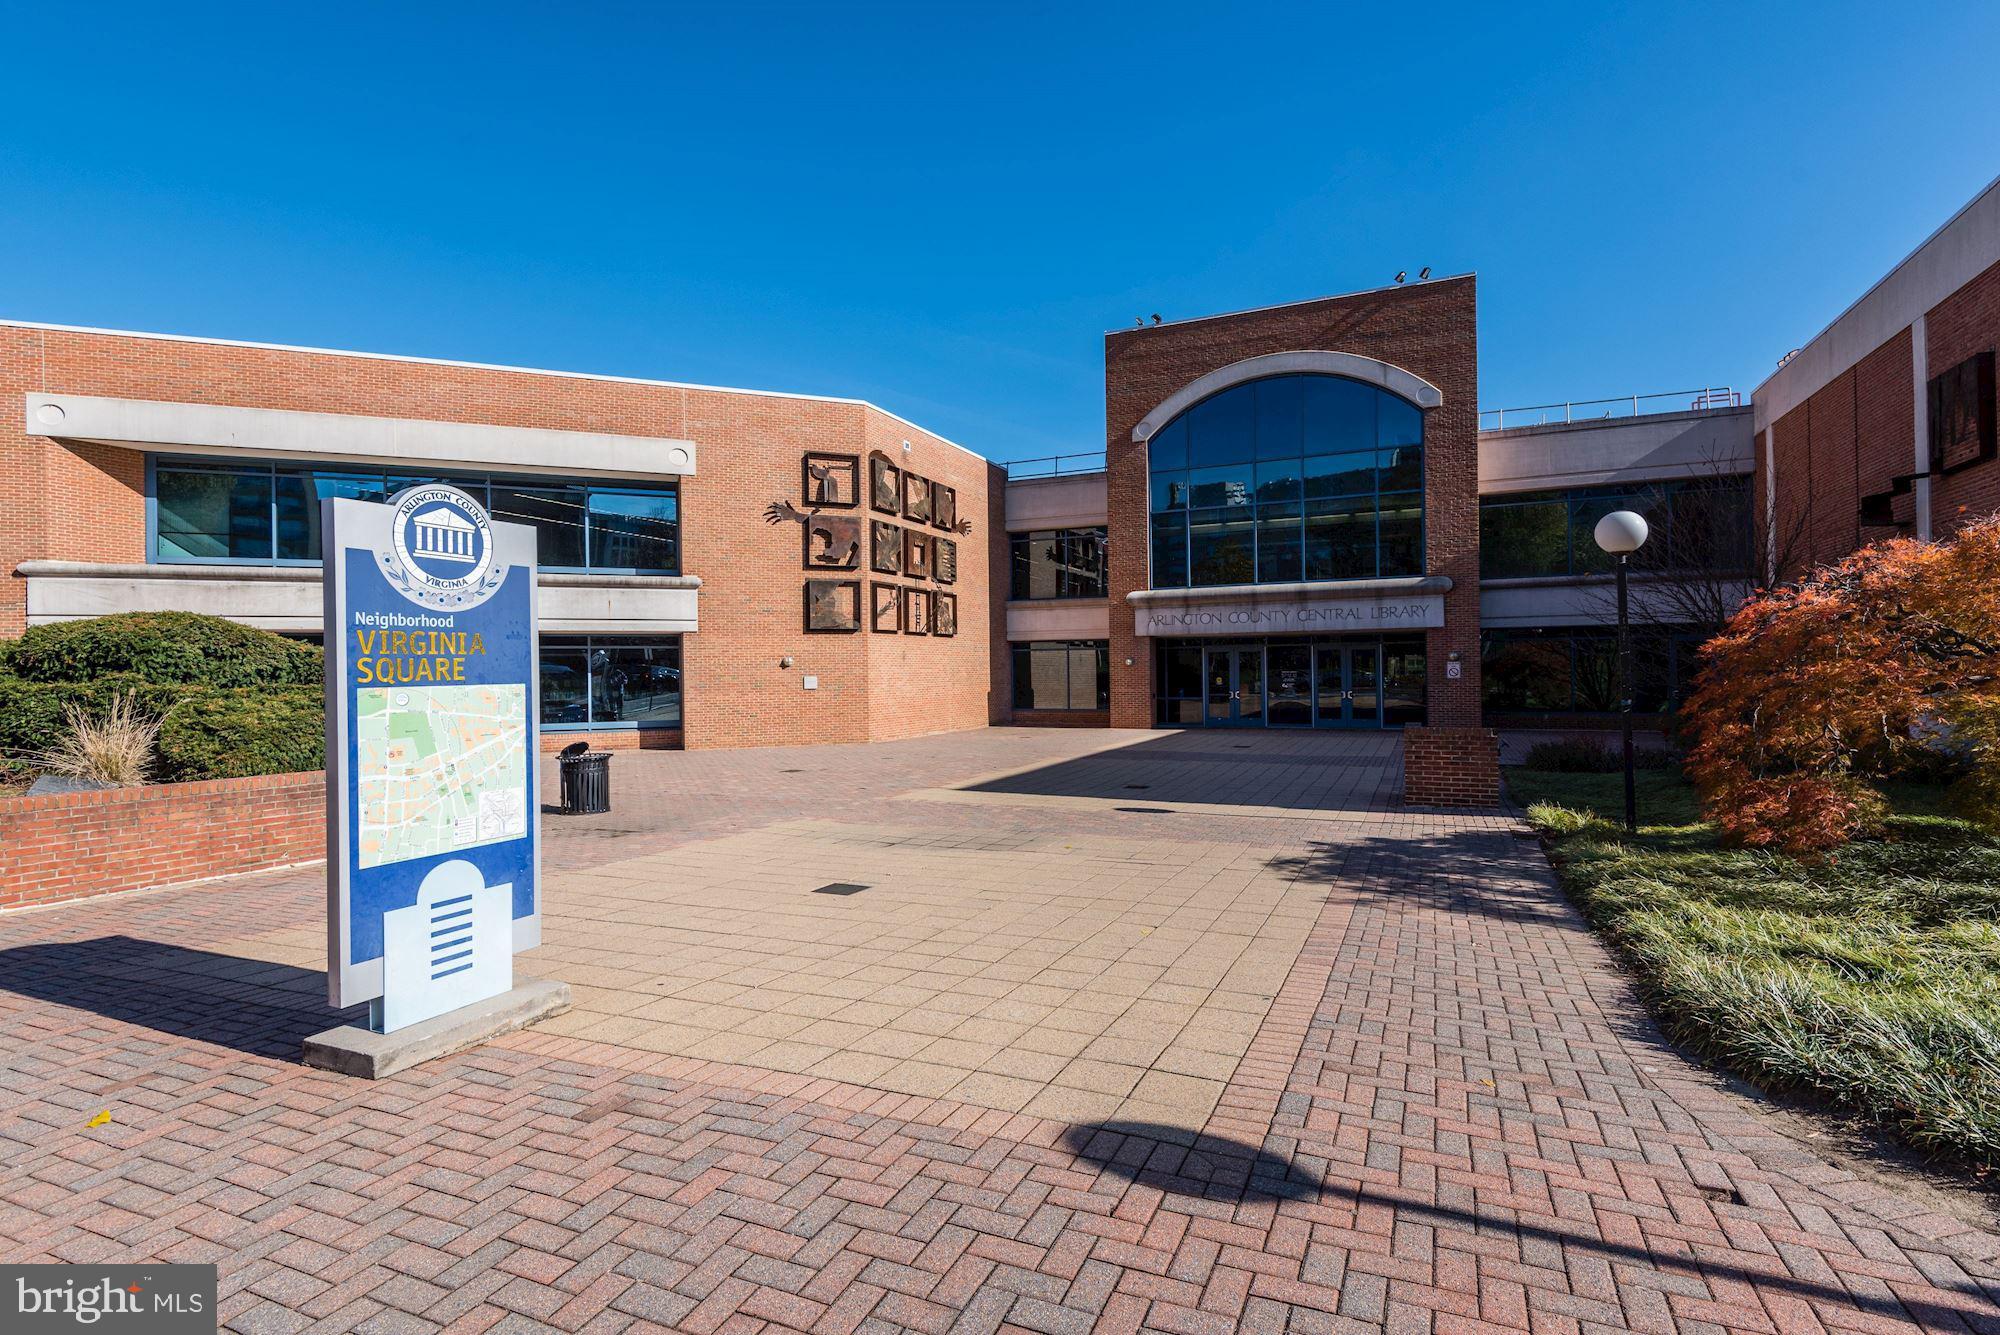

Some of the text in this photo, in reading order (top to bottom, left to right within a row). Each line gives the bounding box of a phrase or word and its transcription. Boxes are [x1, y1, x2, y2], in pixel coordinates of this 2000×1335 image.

[401, 491, 487, 530] ARLINGTON COUNTY
[425, 575, 468, 589] VIRGINIA
[355, 611, 454, 629] Neighborhood
[1147, 604, 1430, 627] ARLINGTON COUNTY CENTRAL LIBRARY
[356, 629, 487, 656] VIRGINIA
[357, 657, 466, 684] SQUARE
